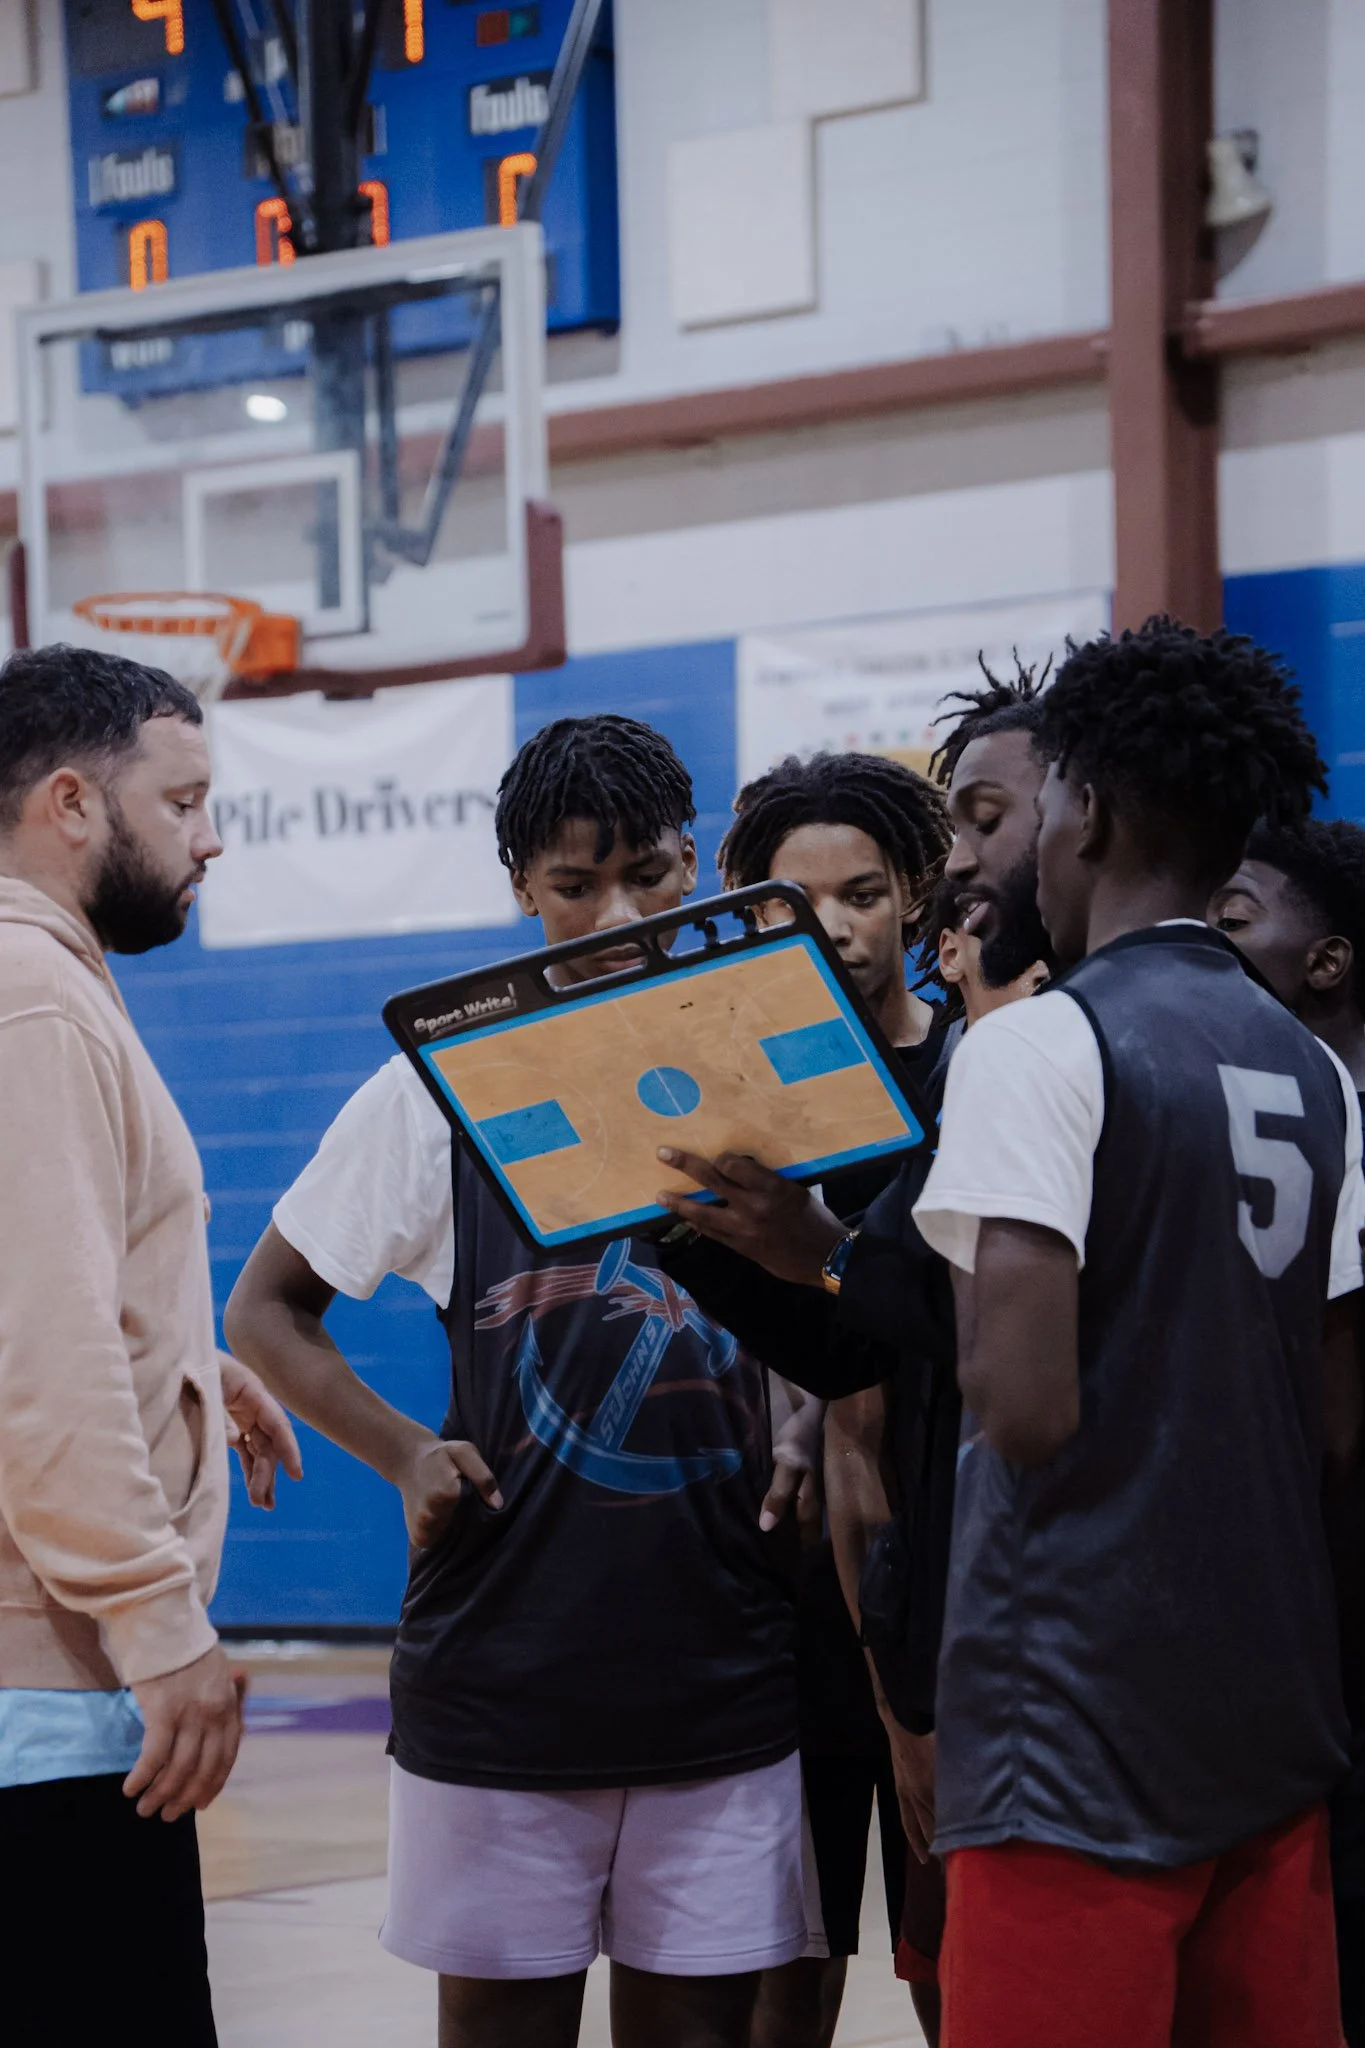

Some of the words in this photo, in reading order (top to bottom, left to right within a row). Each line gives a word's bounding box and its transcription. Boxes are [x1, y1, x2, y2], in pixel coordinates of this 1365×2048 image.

[212, 788, 303, 842] Pile
[413, 1008, 464, 1034] Sport
[1217, 1064, 1314, 1280] 5
